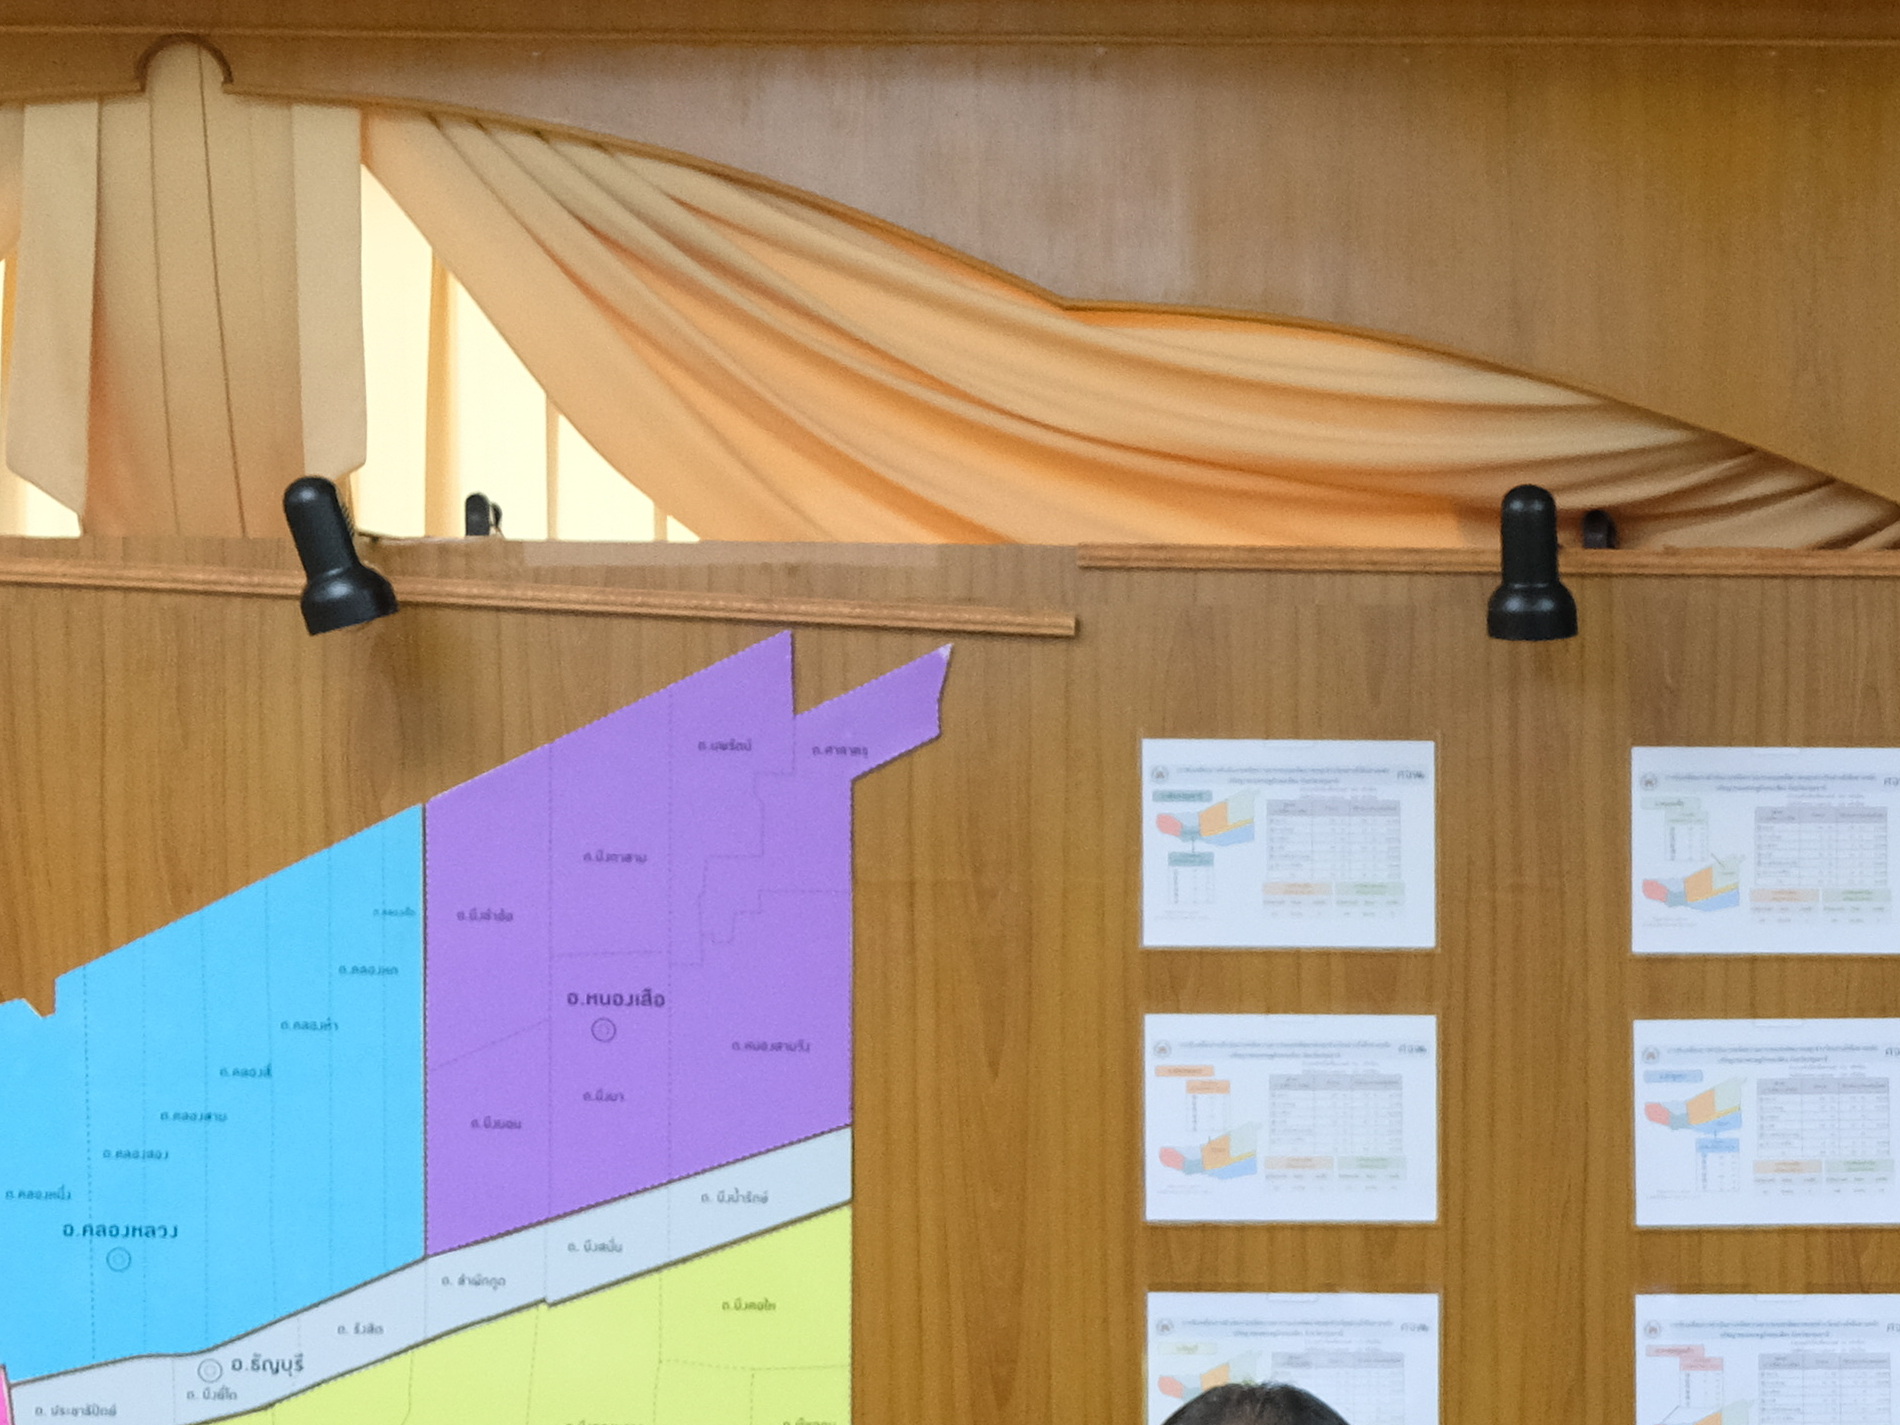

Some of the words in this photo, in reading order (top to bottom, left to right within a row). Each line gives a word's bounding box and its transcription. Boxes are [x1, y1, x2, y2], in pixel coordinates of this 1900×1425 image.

[567, 988, 665, 1008] อ.หนองเสือ
[63, 1224, 178, 1239] อ.คลองหลวง
[231, 1352, 304, 1376] อ.ธัญบุรี
